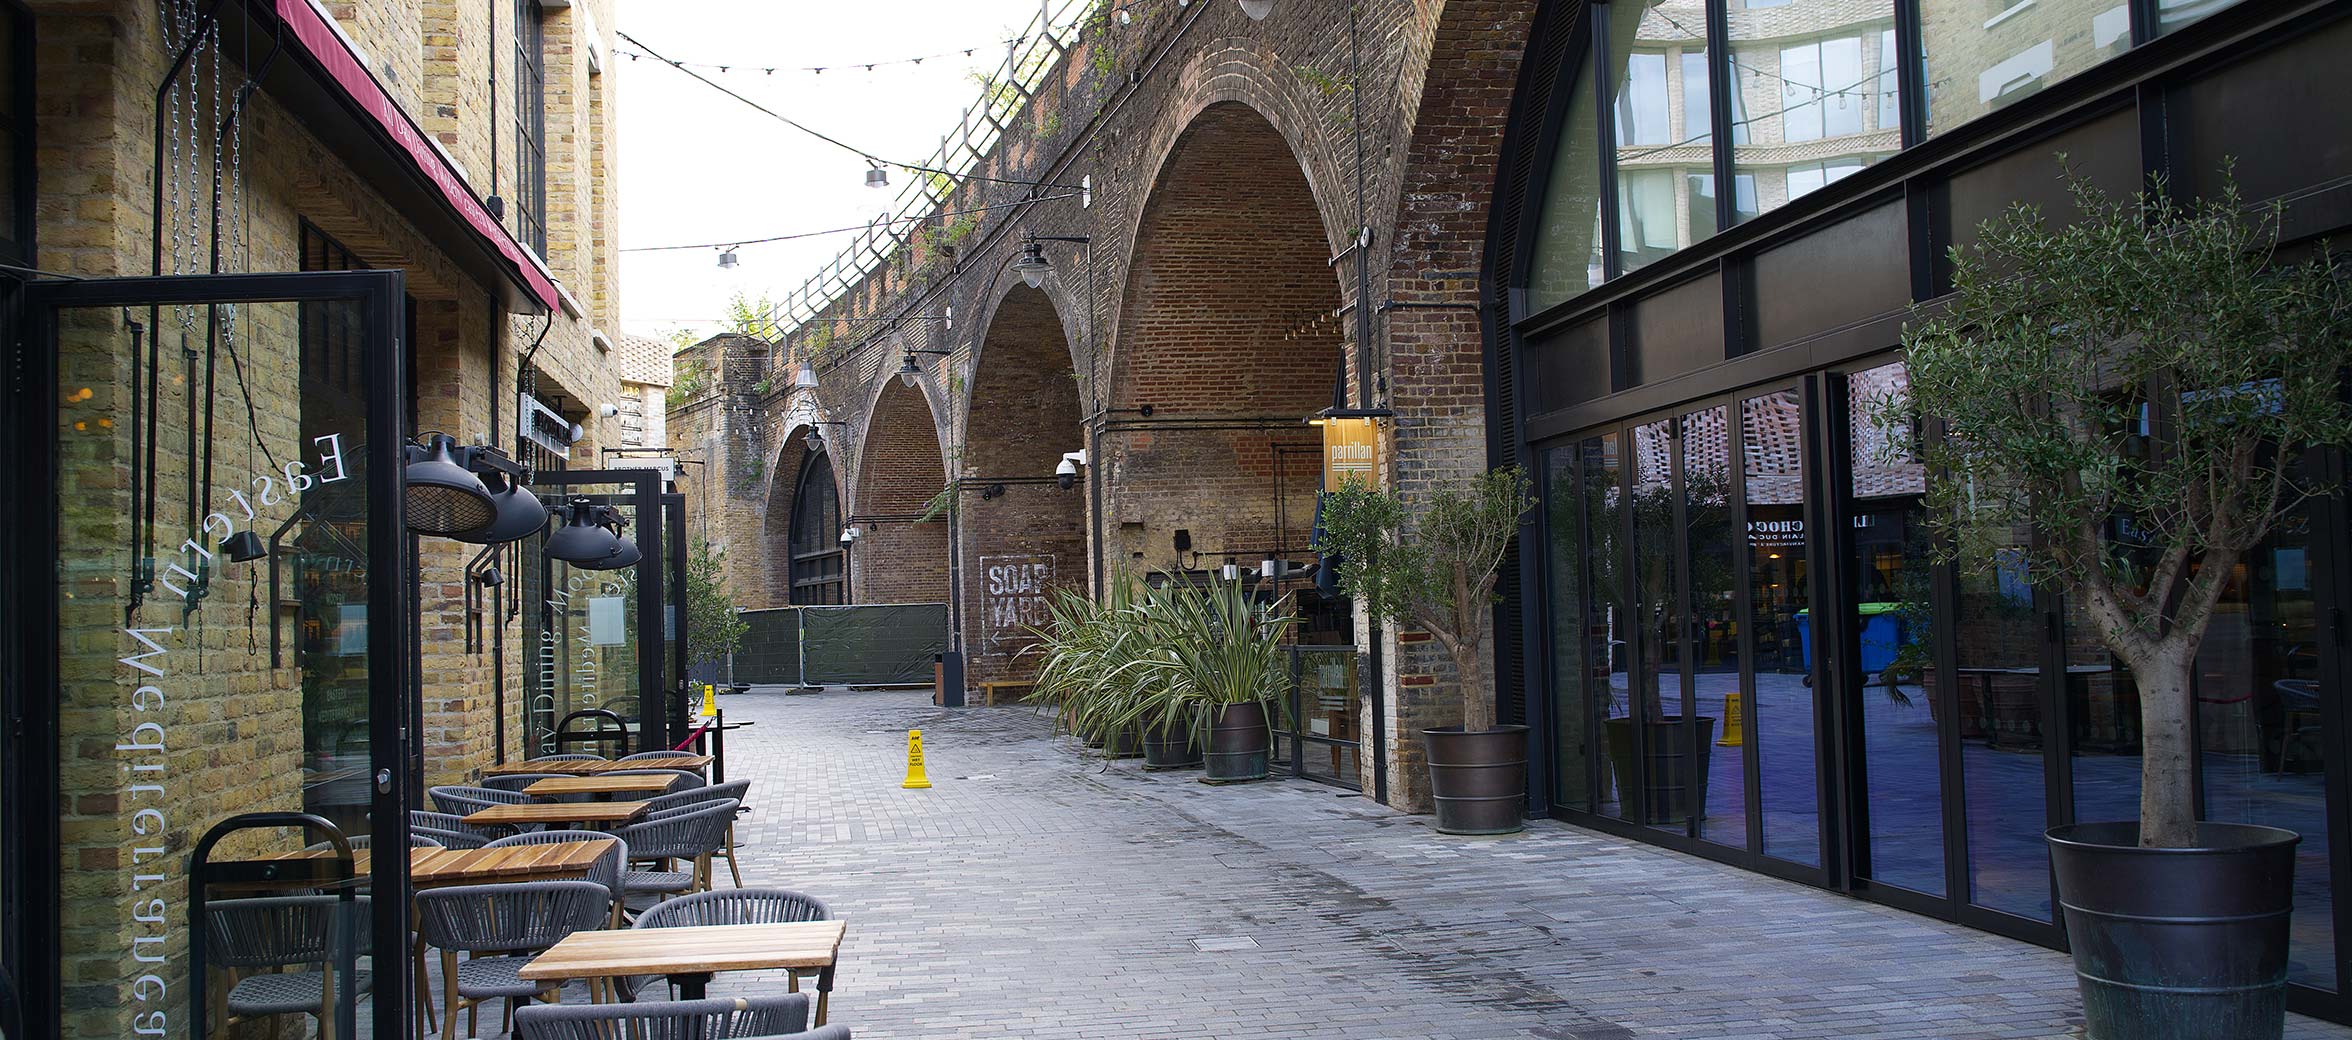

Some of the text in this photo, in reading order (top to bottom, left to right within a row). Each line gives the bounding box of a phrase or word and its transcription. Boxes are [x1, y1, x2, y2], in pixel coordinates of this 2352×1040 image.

[1331, 441, 1373, 461] parrillan
[989, 564, 1050, 627] SOAP YARD
